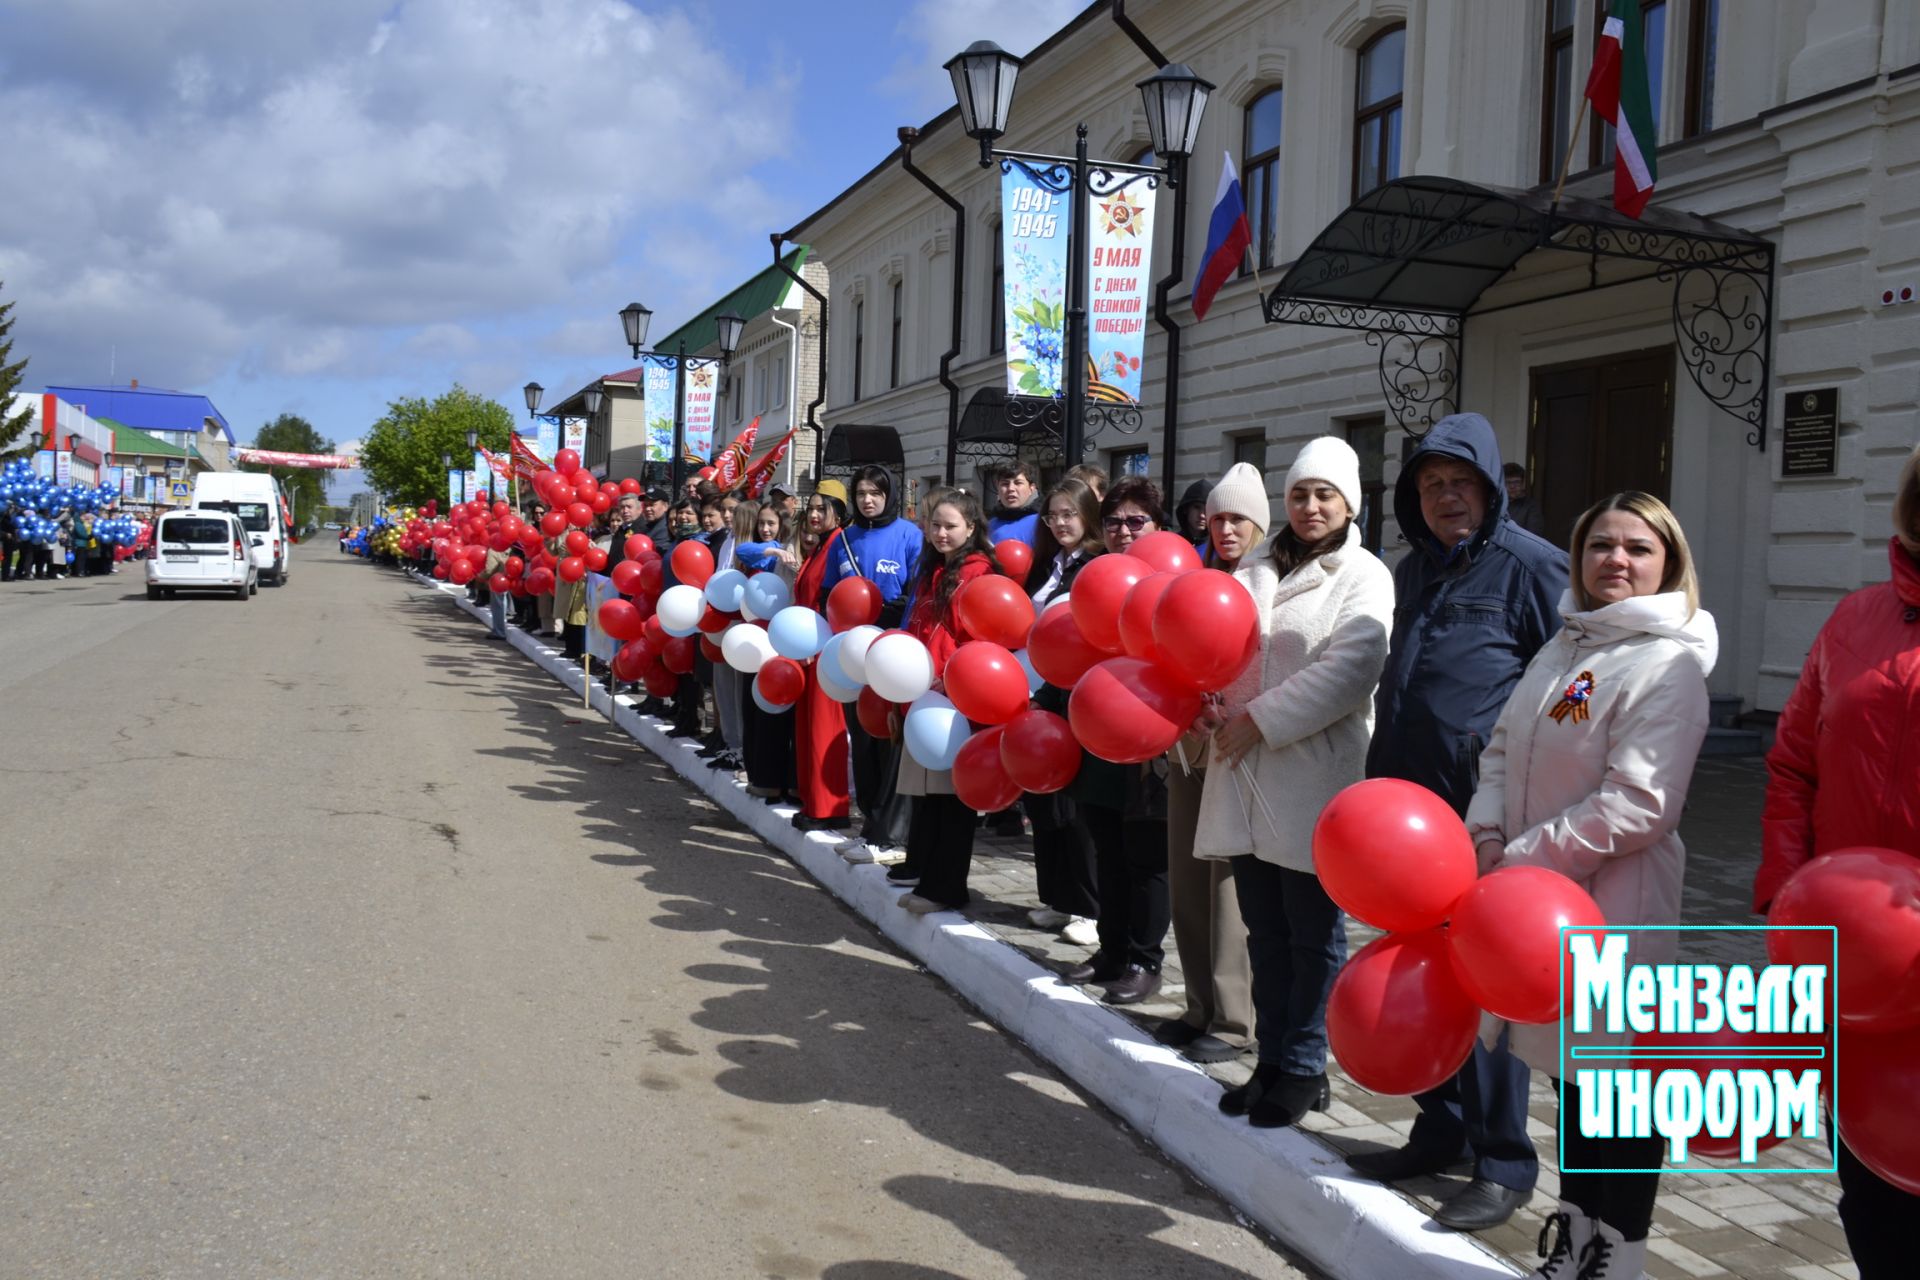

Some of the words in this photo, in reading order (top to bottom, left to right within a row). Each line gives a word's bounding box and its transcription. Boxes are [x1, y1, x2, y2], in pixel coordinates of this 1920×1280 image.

[1011, 187, 1059, 213] 1941-
[1011, 213, 1058, 239] 1945
[1093, 248, 1103, 267] 9
[1106, 247, 1142, 268] МАЯ
[1094, 278, 1102, 292] С
[1105, 277, 1137, 293] ДНЕМ
[1093, 297, 1141, 314] ВЕЛИКОЙ
[1094, 318, 1142, 335] ПОБЕДЫ!
[693, 393, 712, 402] МАЯ
